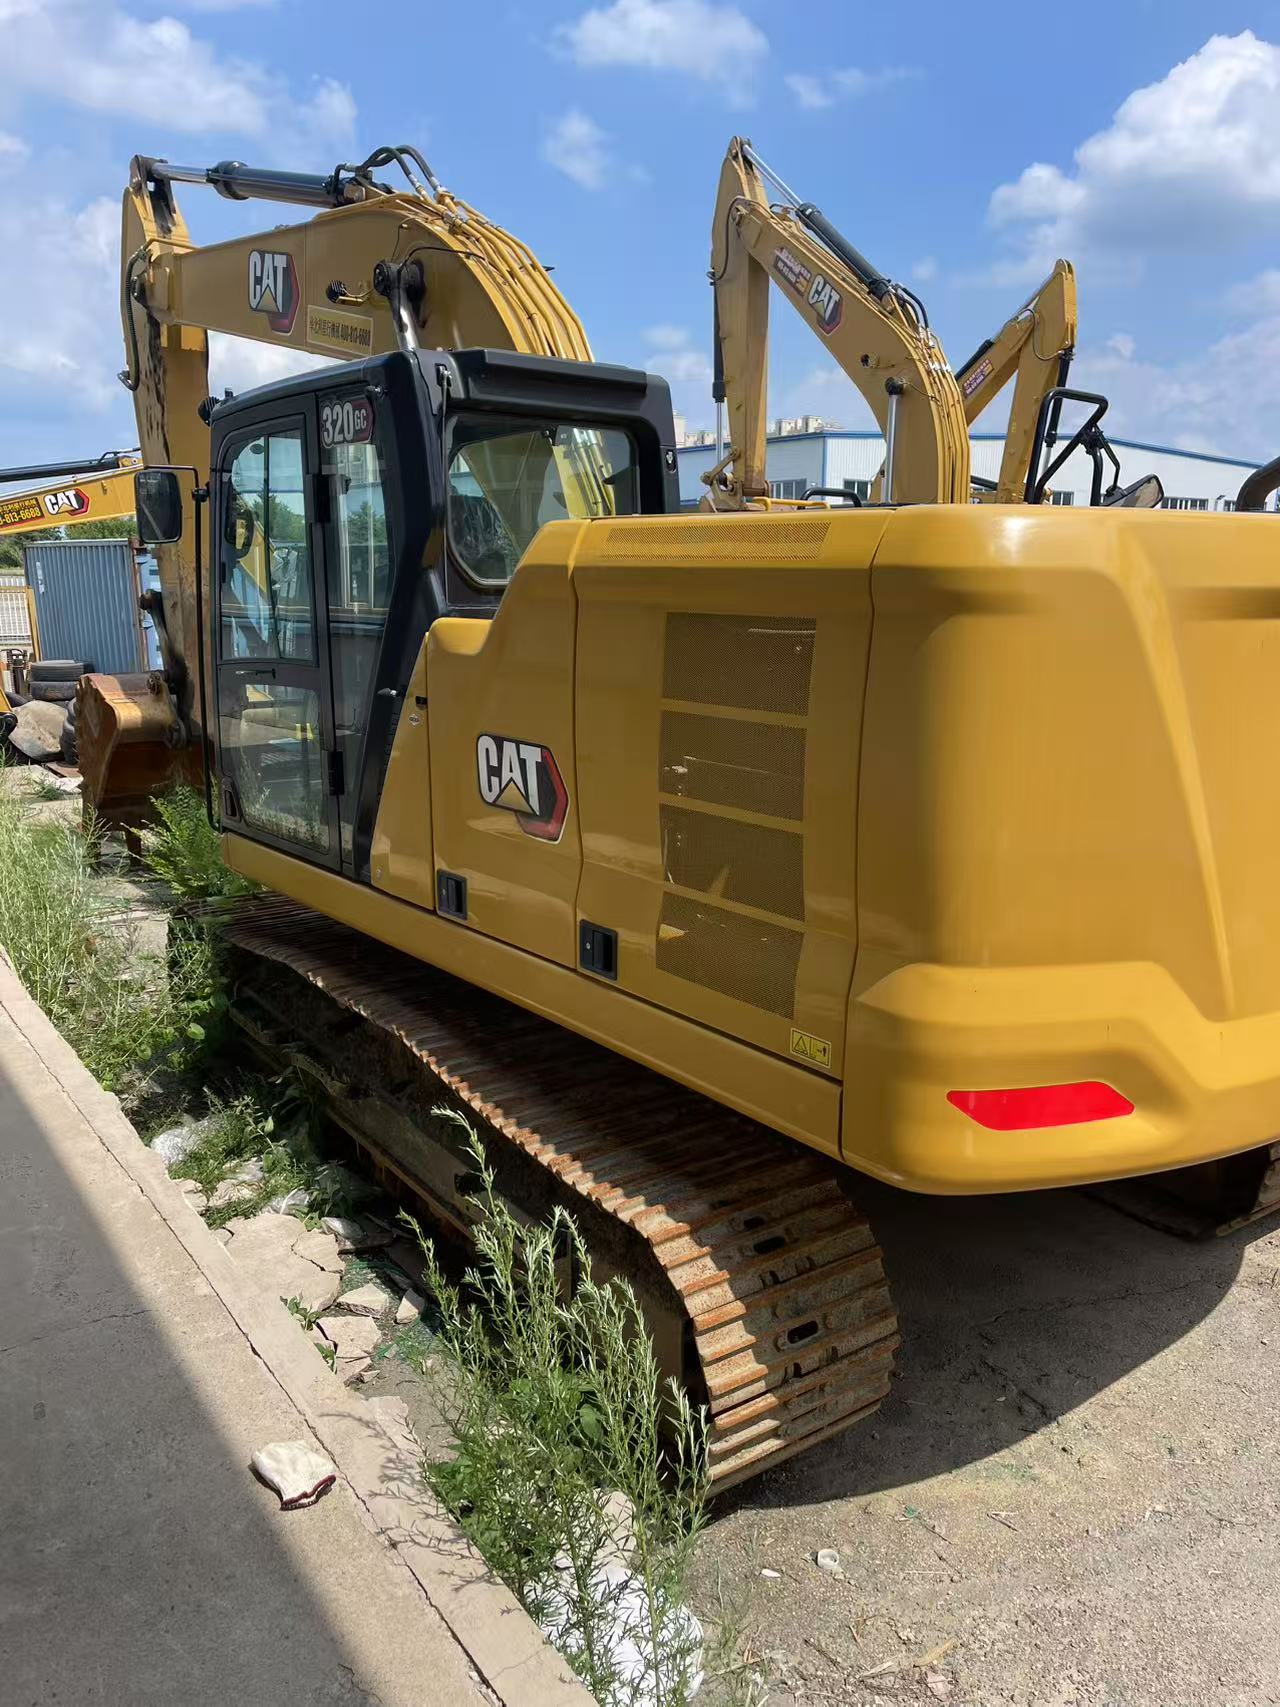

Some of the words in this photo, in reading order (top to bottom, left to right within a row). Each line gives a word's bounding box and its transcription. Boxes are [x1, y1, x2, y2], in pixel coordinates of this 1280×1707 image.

[250, 251, 287, 313] CAT
[809, 275, 841, 321] CAT
[323, 402, 354, 444] 320
[354, 408, 367, 430] GC
[44, 490, 79, 515] CAT
[477, 735, 542, 816] CAT
